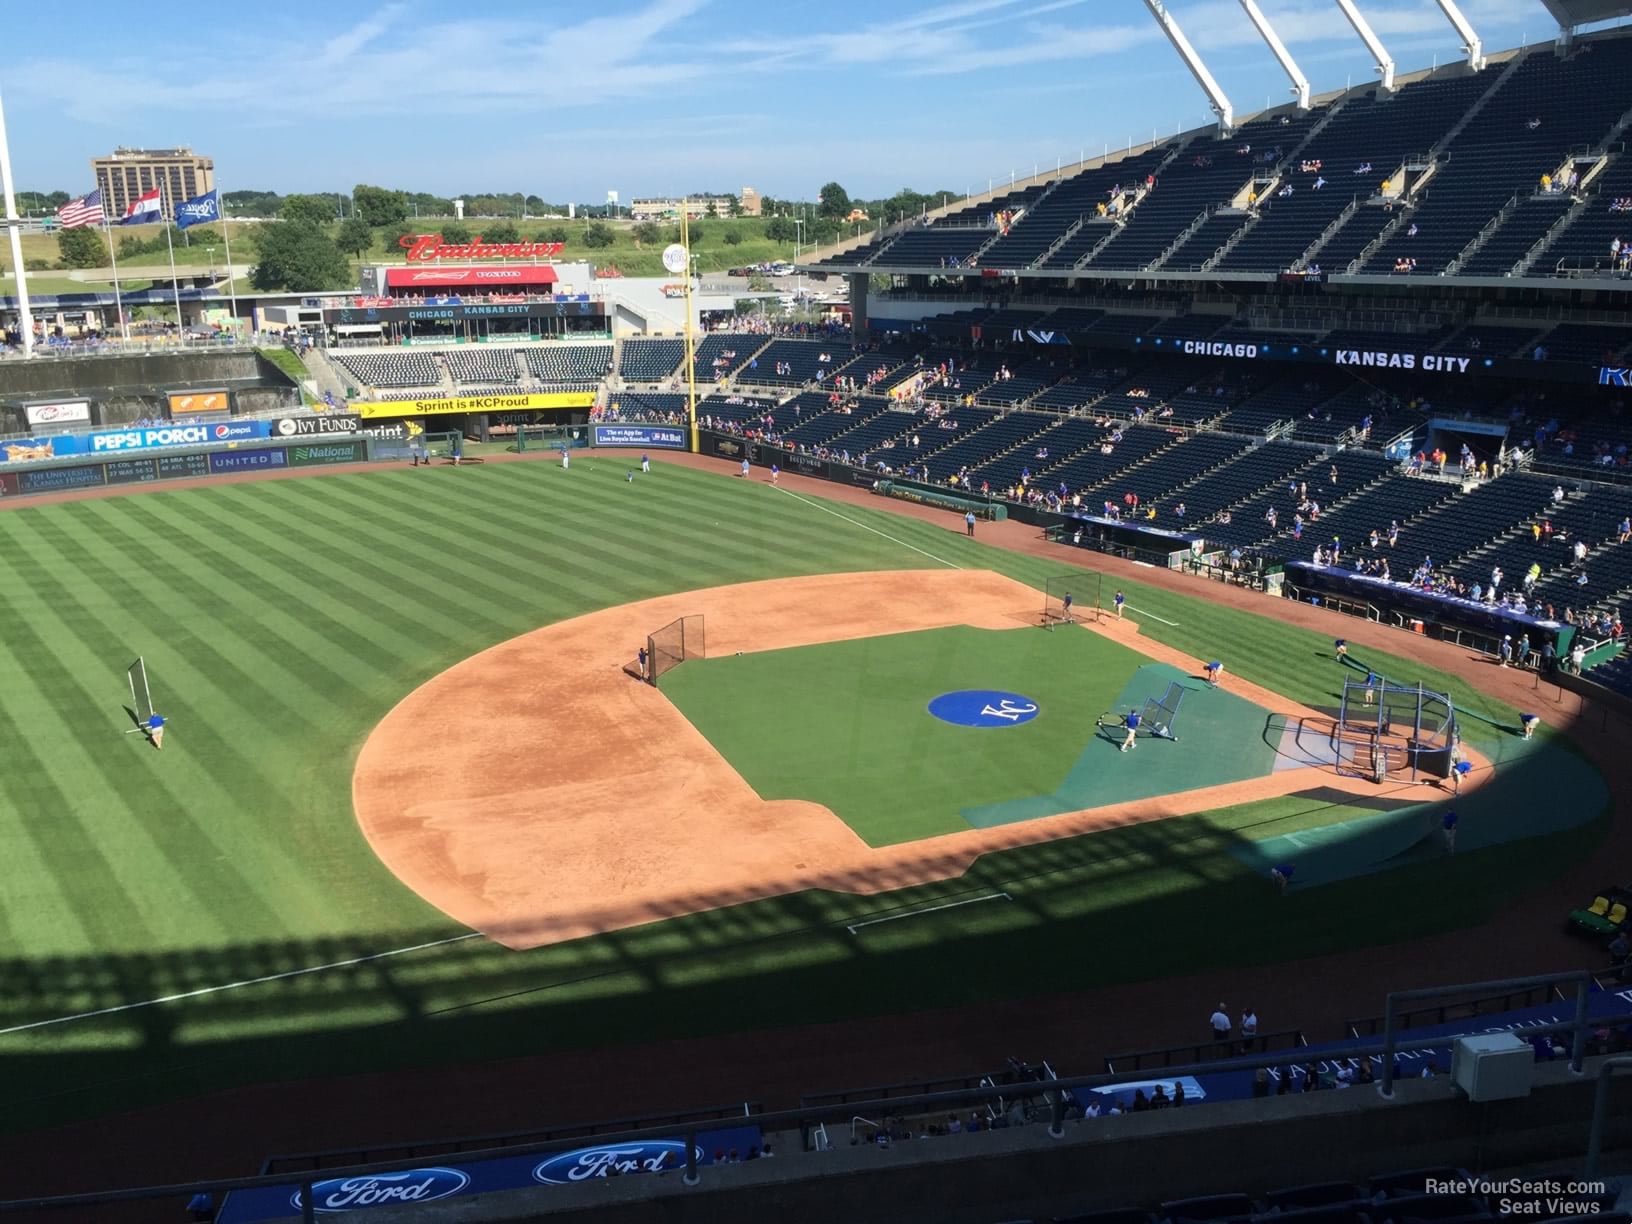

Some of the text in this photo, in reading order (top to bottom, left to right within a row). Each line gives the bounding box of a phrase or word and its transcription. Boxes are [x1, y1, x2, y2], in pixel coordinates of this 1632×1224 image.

[400, 233, 565, 263] Budweiser
[409, 311, 454, 319] CHICAGO
[464, 307, 505, 315] KANSAS
[1184, 340, 1257, 358] CHICAGO
[1335, 350, 1470, 373] KANSAS CITY
[416, 396, 529, 413] Sprint is #KCProud
[230, 426, 251, 436] pepsi
[296, 418, 357, 434] IVY FUNDS
[93, 427, 208, 450] PEPSI PORCH
[661, 433, 669, 441] At
[308, 445, 354, 459] National
[215, 455, 268, 467] UNITED
[30, 468, 93, 481] THE UNIVERSITY
[981, 700, 1037, 721] KC
[326, 1173, 432, 1208] Ford
